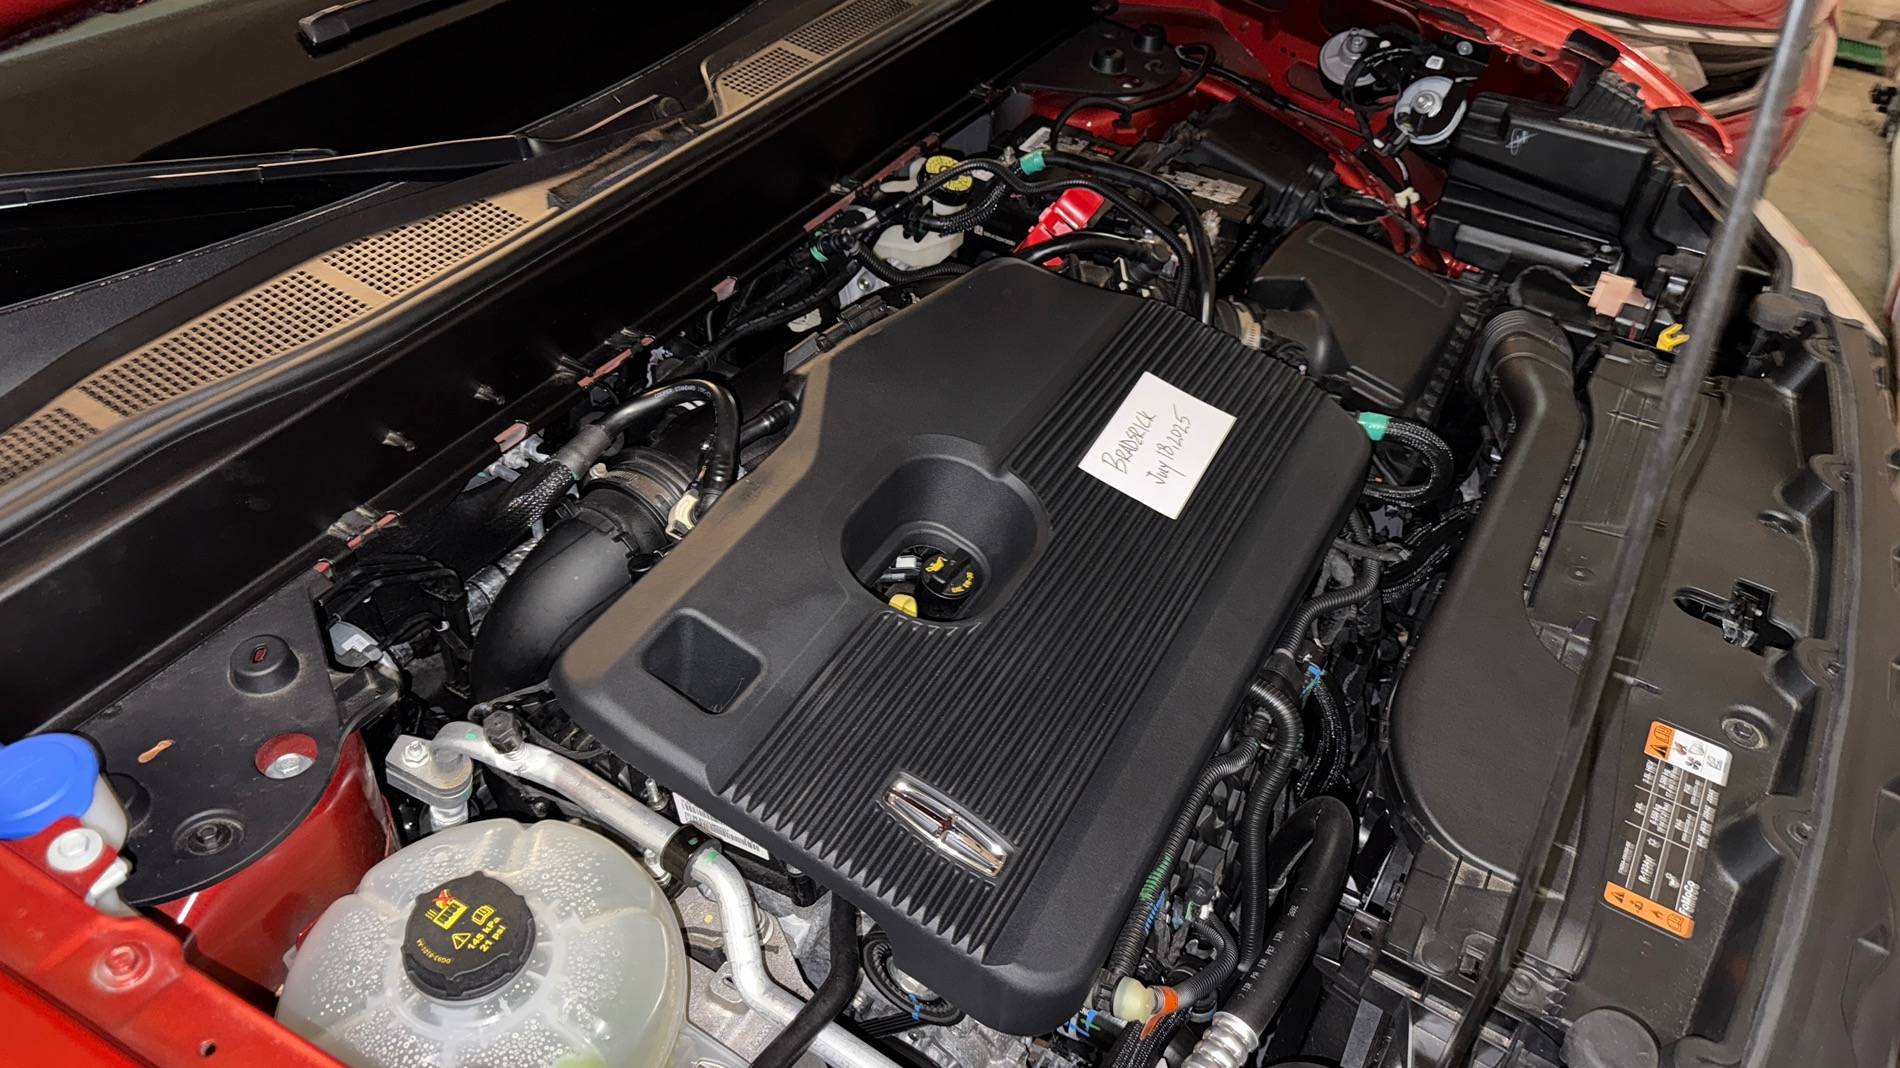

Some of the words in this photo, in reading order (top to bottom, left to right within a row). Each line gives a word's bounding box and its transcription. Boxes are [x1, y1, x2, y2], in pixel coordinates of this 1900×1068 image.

[1678, 879, 1700, 917] FoMoCo
[468, 932, 486, 950] 145
[483, 916, 501, 933] kPa
[480, 939, 493, 953] 21
[491, 924, 507, 941] psi
